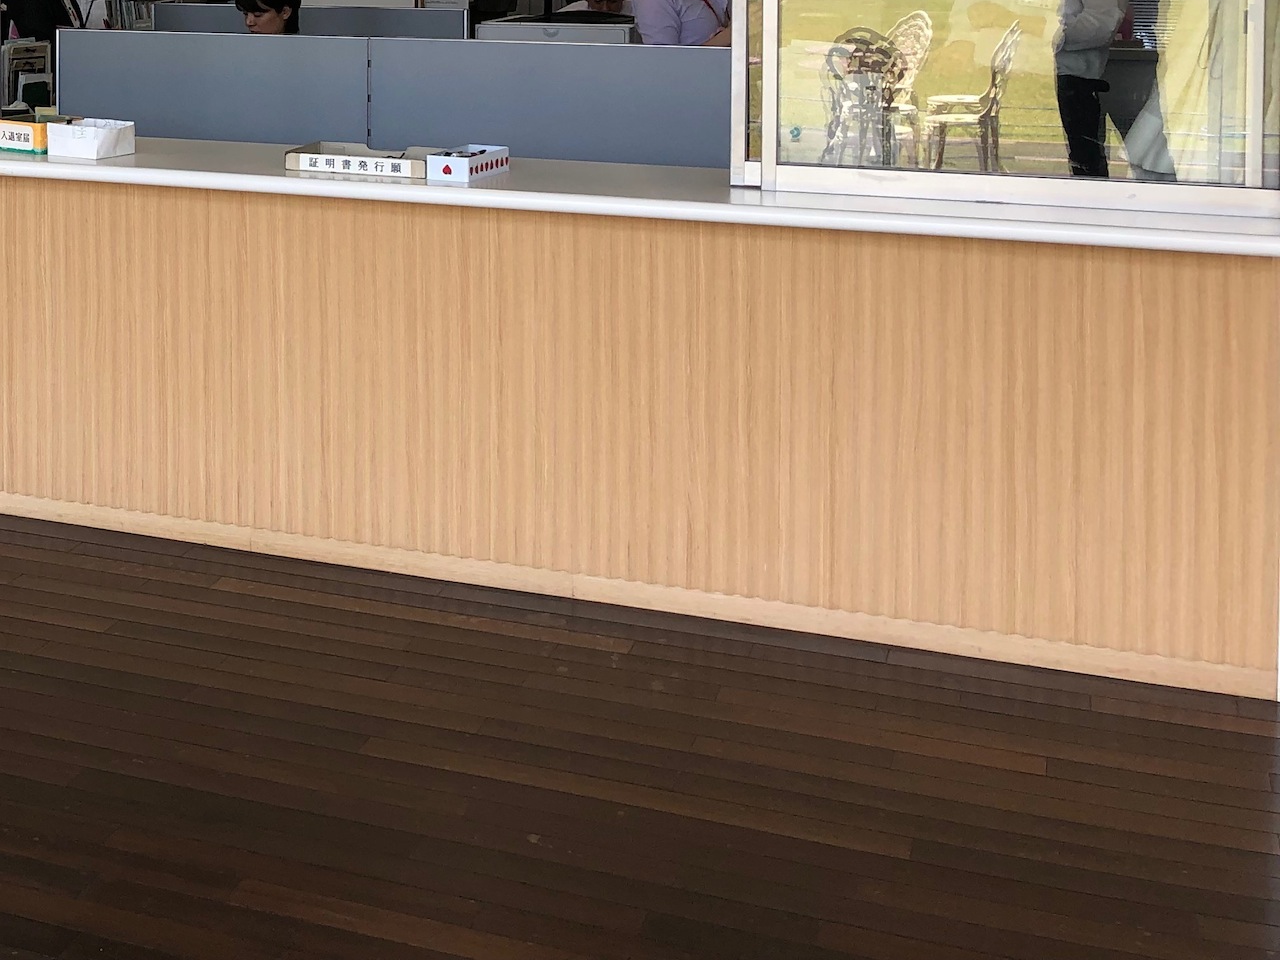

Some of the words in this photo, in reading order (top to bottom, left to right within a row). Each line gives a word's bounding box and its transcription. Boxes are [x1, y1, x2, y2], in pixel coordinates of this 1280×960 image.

[0, 130, 31, 143] 入退室届
[308, 156, 403, 174] 証明書発行願
